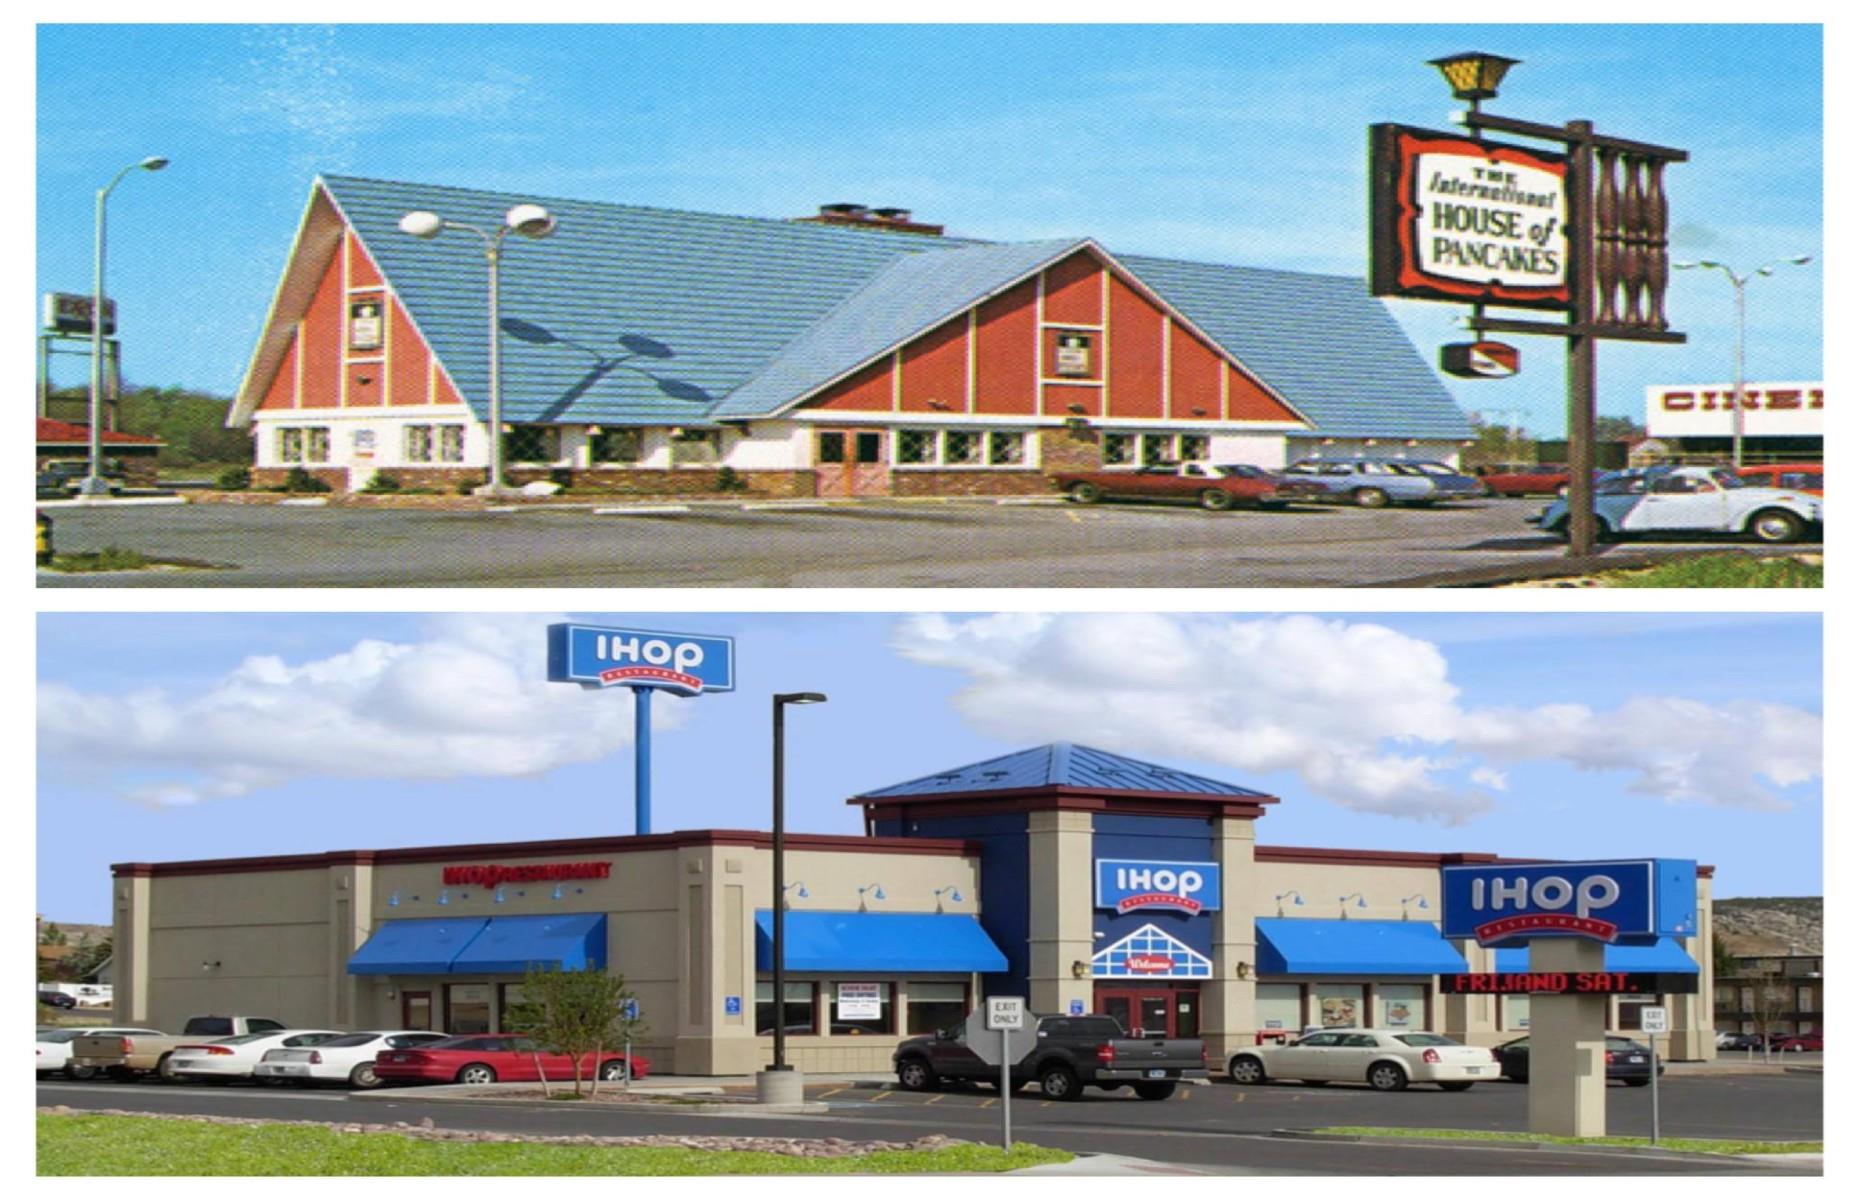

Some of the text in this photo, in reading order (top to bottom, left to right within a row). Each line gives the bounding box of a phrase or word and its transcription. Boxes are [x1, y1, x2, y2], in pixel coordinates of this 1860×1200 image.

[1473, 166, 1517, 184] THE
[1428, 171, 1557, 208] International
[1432, 200, 1558, 247] HOUSE of
[1432, 235, 1559, 275] PANCAKES
[597, 634, 704, 674] IHOP
[1116, 867, 1203, 899] IHOP
[1471, 874, 1620, 919] IHOP
[1482, 917, 1607, 935] RESTAURANT
[1127, 957, 1171, 970] Welcome
[1575, 973, 1638, 992] SAT.
[993, 1014, 1019, 1024] ONLY
[995, 1002, 1017, 1012] EXIT
